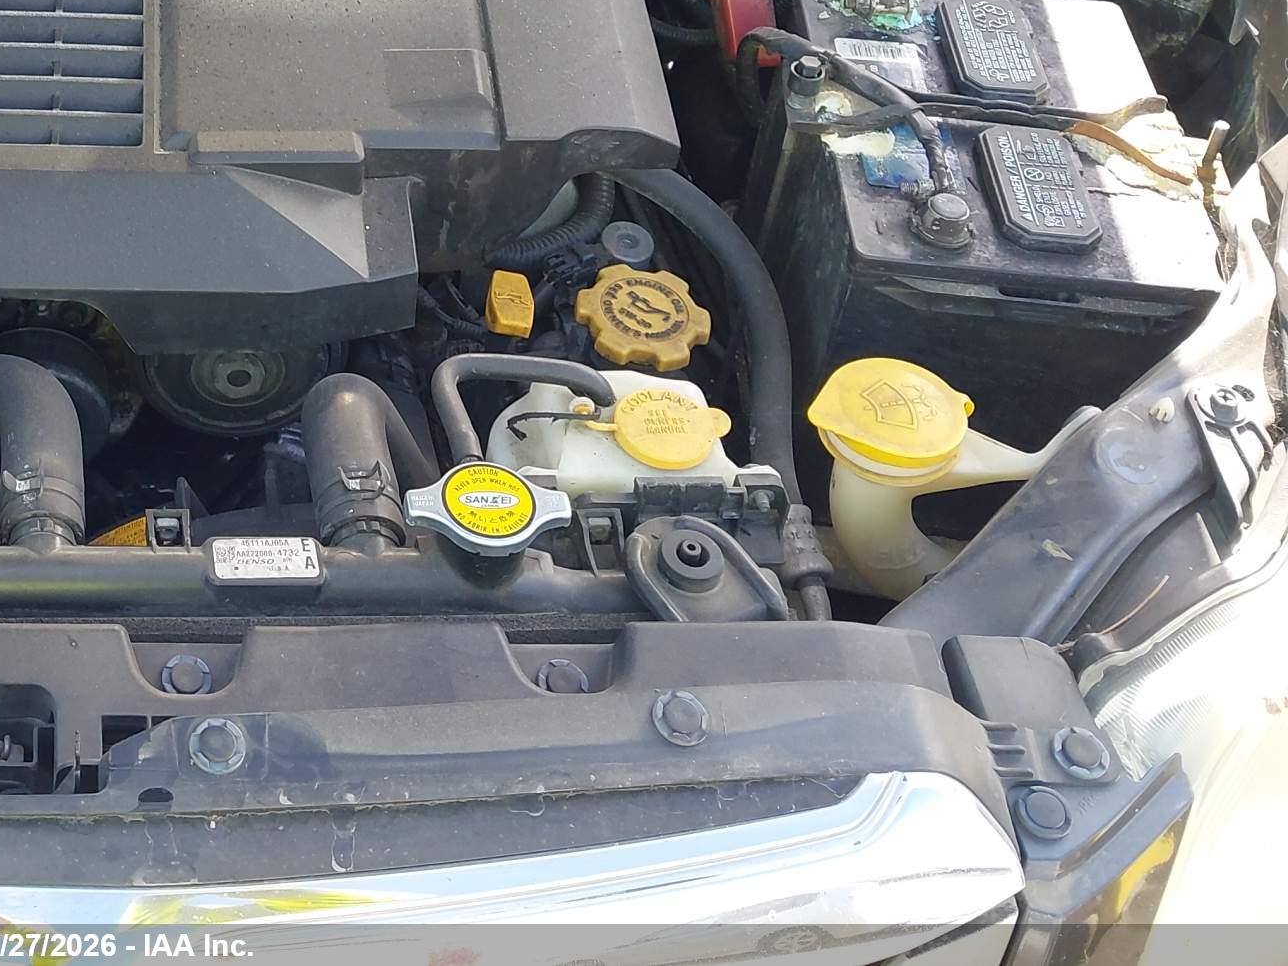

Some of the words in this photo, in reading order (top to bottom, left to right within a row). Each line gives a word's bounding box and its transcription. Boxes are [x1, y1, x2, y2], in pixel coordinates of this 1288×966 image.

[996, 135, 1016, 167] POISON
[1008, 175, 1030, 211] DANGER
[626, 280, 674, 298] ENGINE
[621, 390, 698, 414] COOLANT
[467, 468, 498, 477] CAUTION
[300, 537, 312, 552] E
[305, 555, 316, 570] A
